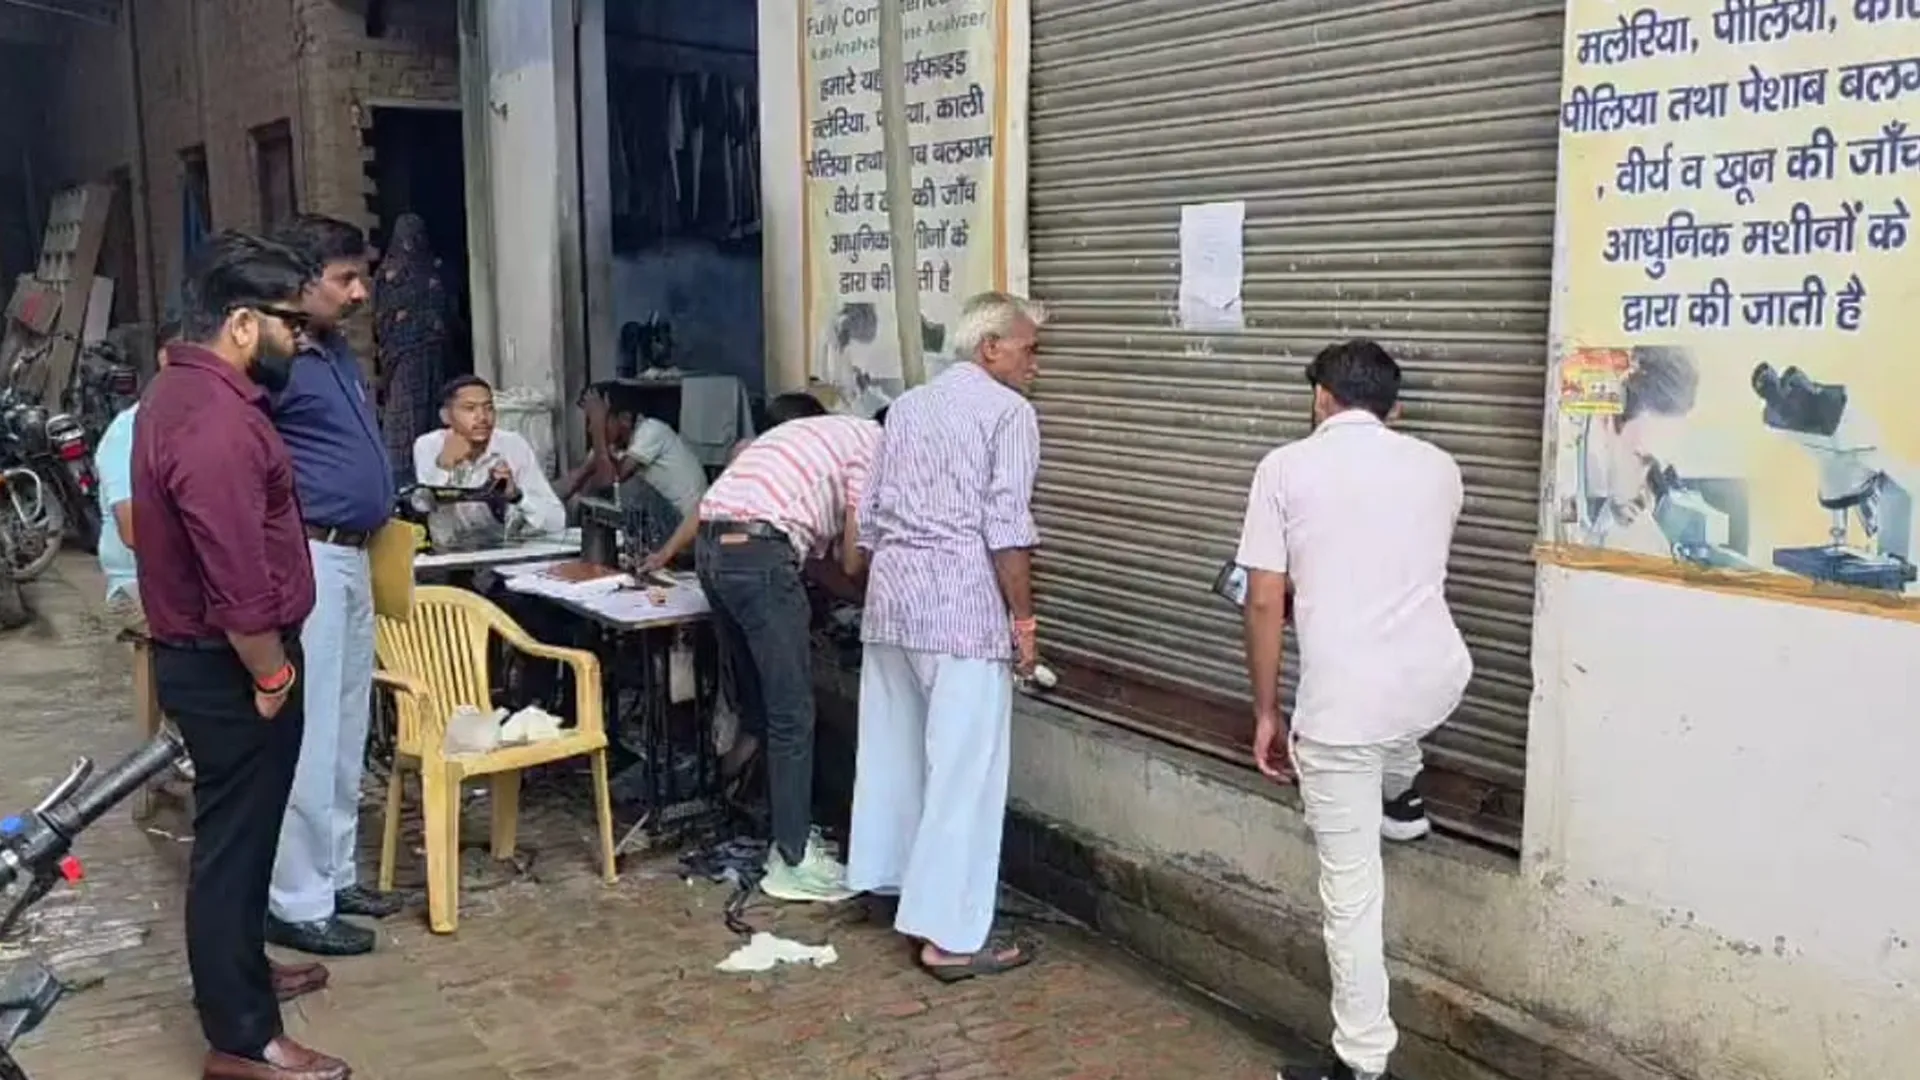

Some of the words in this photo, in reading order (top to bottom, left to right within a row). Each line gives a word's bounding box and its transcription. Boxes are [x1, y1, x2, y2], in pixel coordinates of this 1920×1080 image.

[1577, 9, 1699, 64] मलेरिया,
[820, 66, 857, 101] हमारे
[936, 82, 985, 120] काली
[1562, 83, 1659, 132] पीलिया
[1667, 82, 1729, 122] तथा
[1738, 64, 1829, 113] पेशाब
[1616, 143, 1674, 194] वीर्य
[1680, 155, 1706, 189] व
[1713, 149, 1779, 206] खून
[1786, 126, 1838, 180] की
[1602, 210, 1734, 279] आधुनिक
[1742, 202, 1864, 255] मशीनों
[1867, 199, 1911, 250] के
[1621, 294, 1681, 332] द्वारा
[1687, 278, 1733, 328] की
[1740, 275, 1827, 328] जाती
[1836, 273, 1866, 330] है
